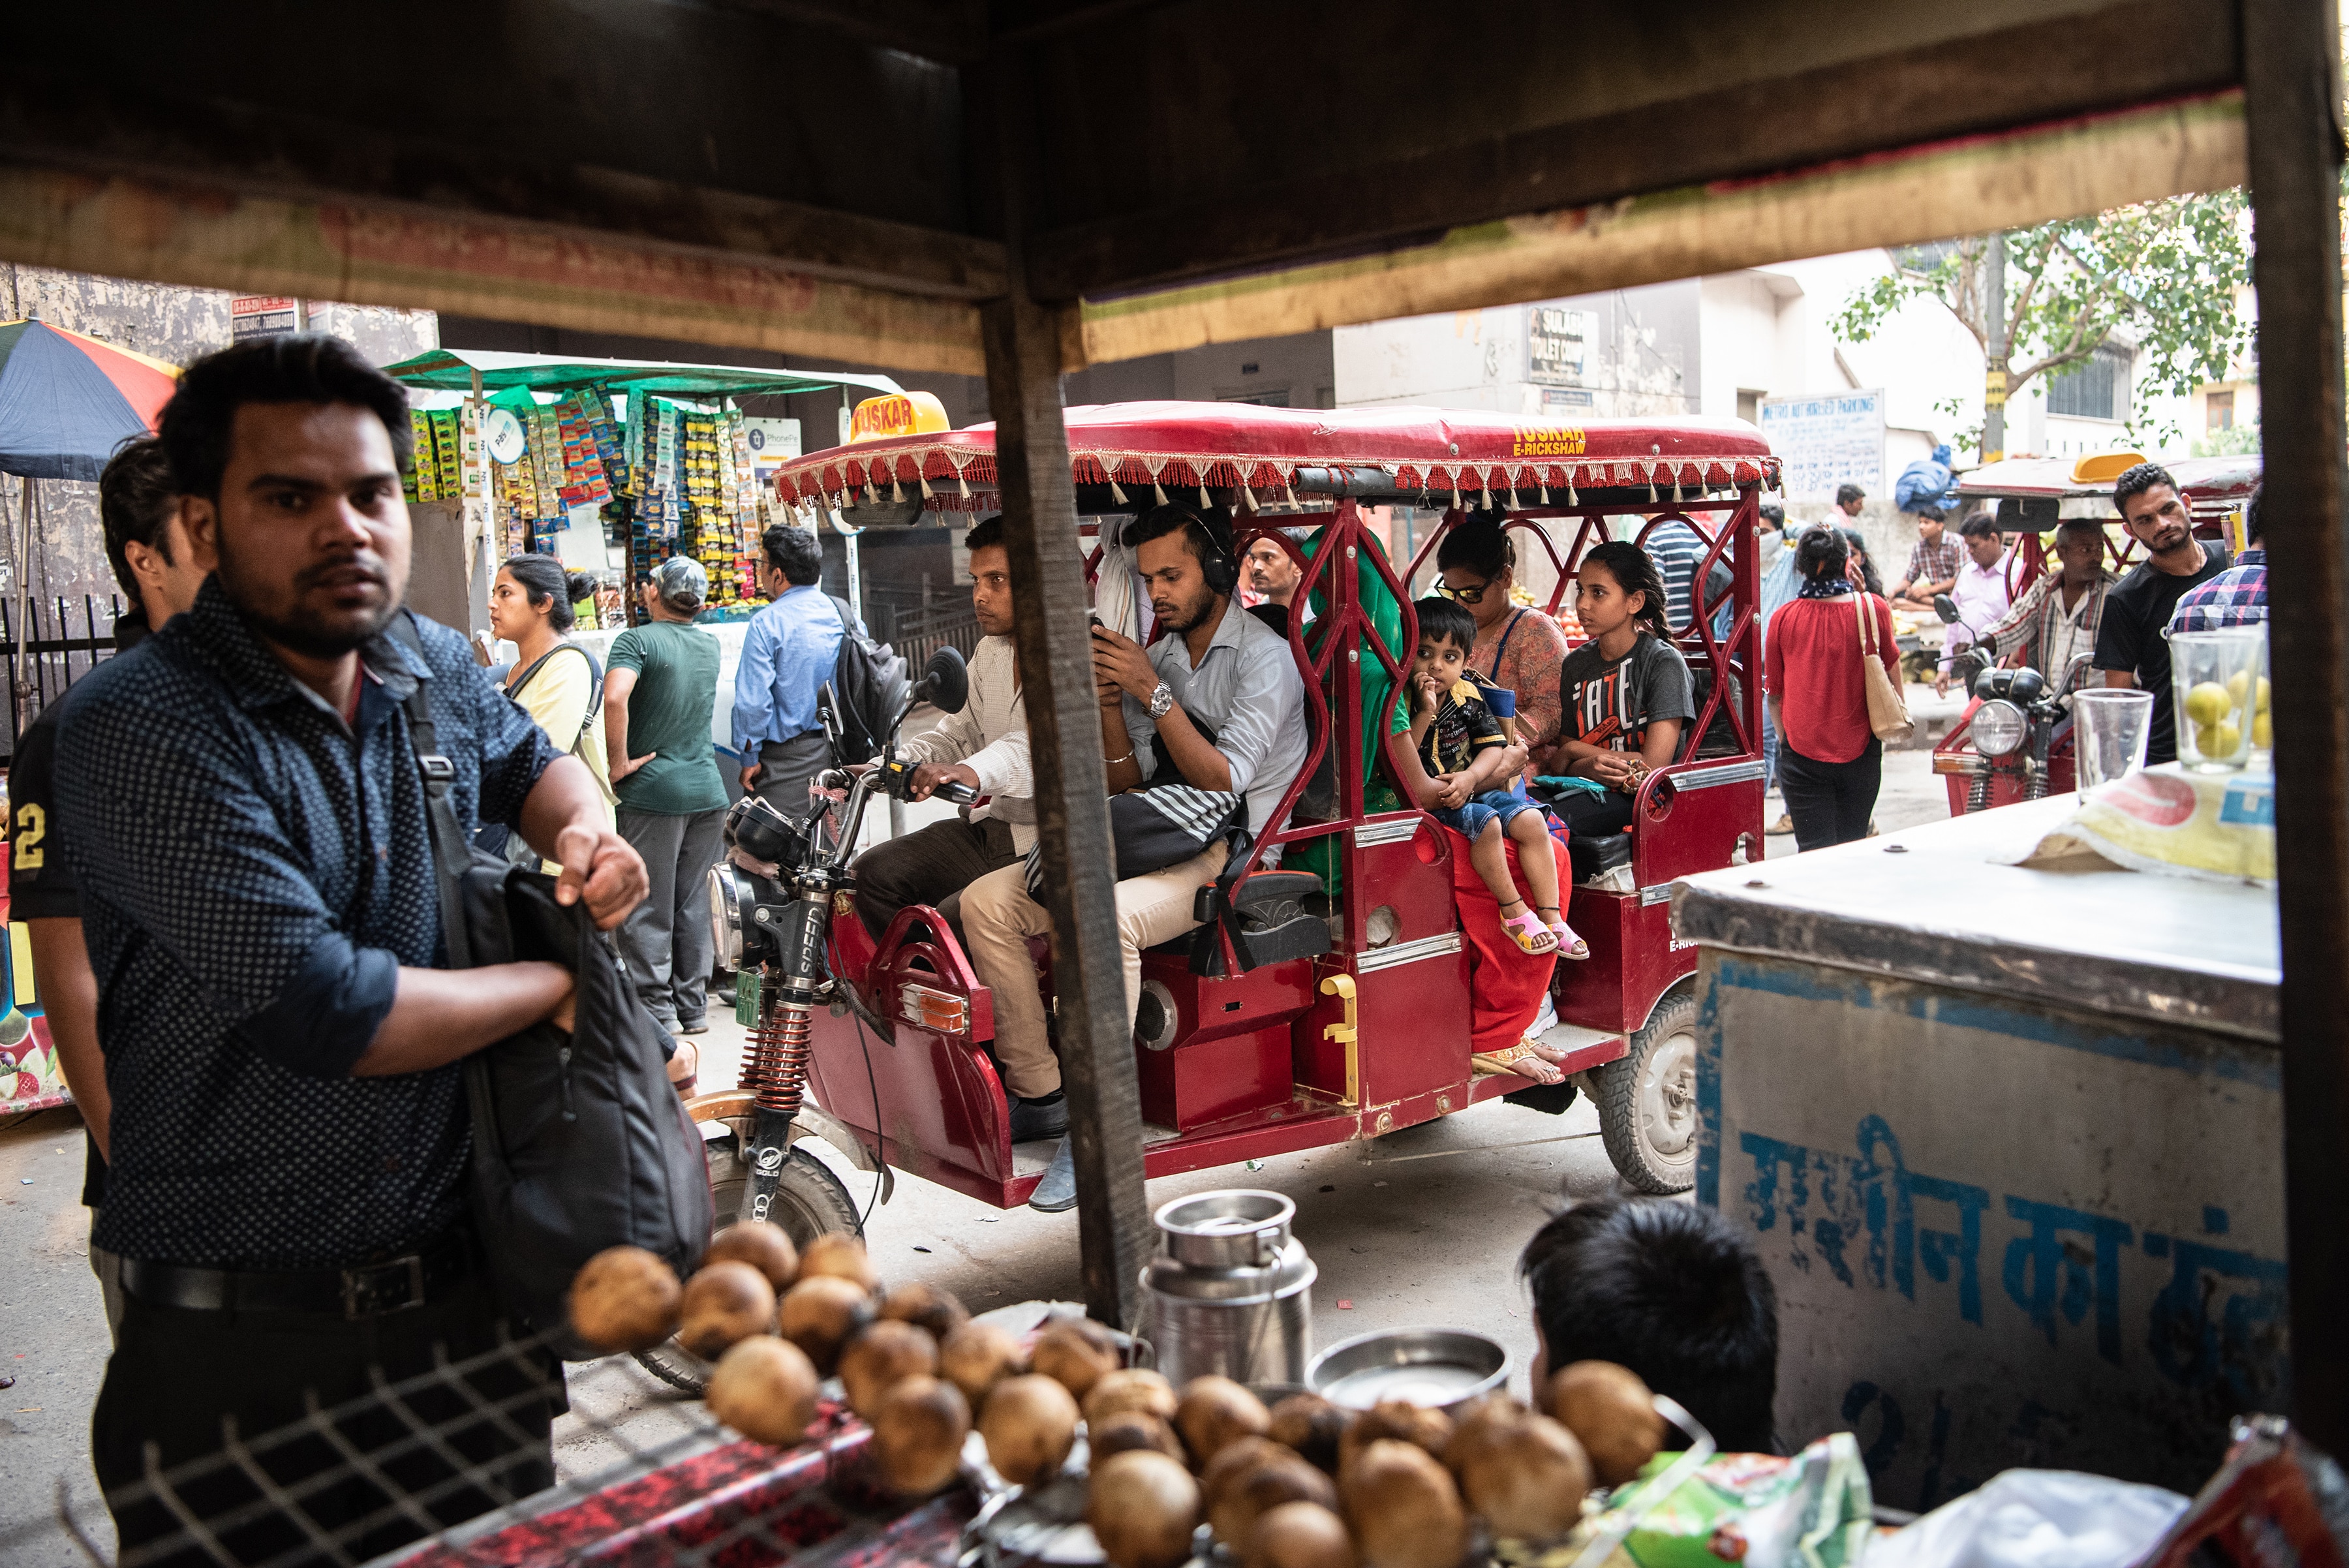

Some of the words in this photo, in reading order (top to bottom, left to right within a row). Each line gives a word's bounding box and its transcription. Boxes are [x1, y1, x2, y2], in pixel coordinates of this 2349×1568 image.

[1529, 336, 1560, 361] TOILET
[852, 399, 912, 436] TUSKAR
[1763, 403, 1788, 421] METRO
[1838, 397, 1874, 415] PARKING
[767, 434, 798, 443] PhonePe
[1512, 425, 1586, 442] TUSKAR
[1513, 442, 1586, 456] E-RICKSHAW
[14, 802, 46, 871] 2
[800, 906, 825, 977] SPEED
[756, 1168, 779, 1177] GOLD
[2003, 1193, 2134, 1366] का
